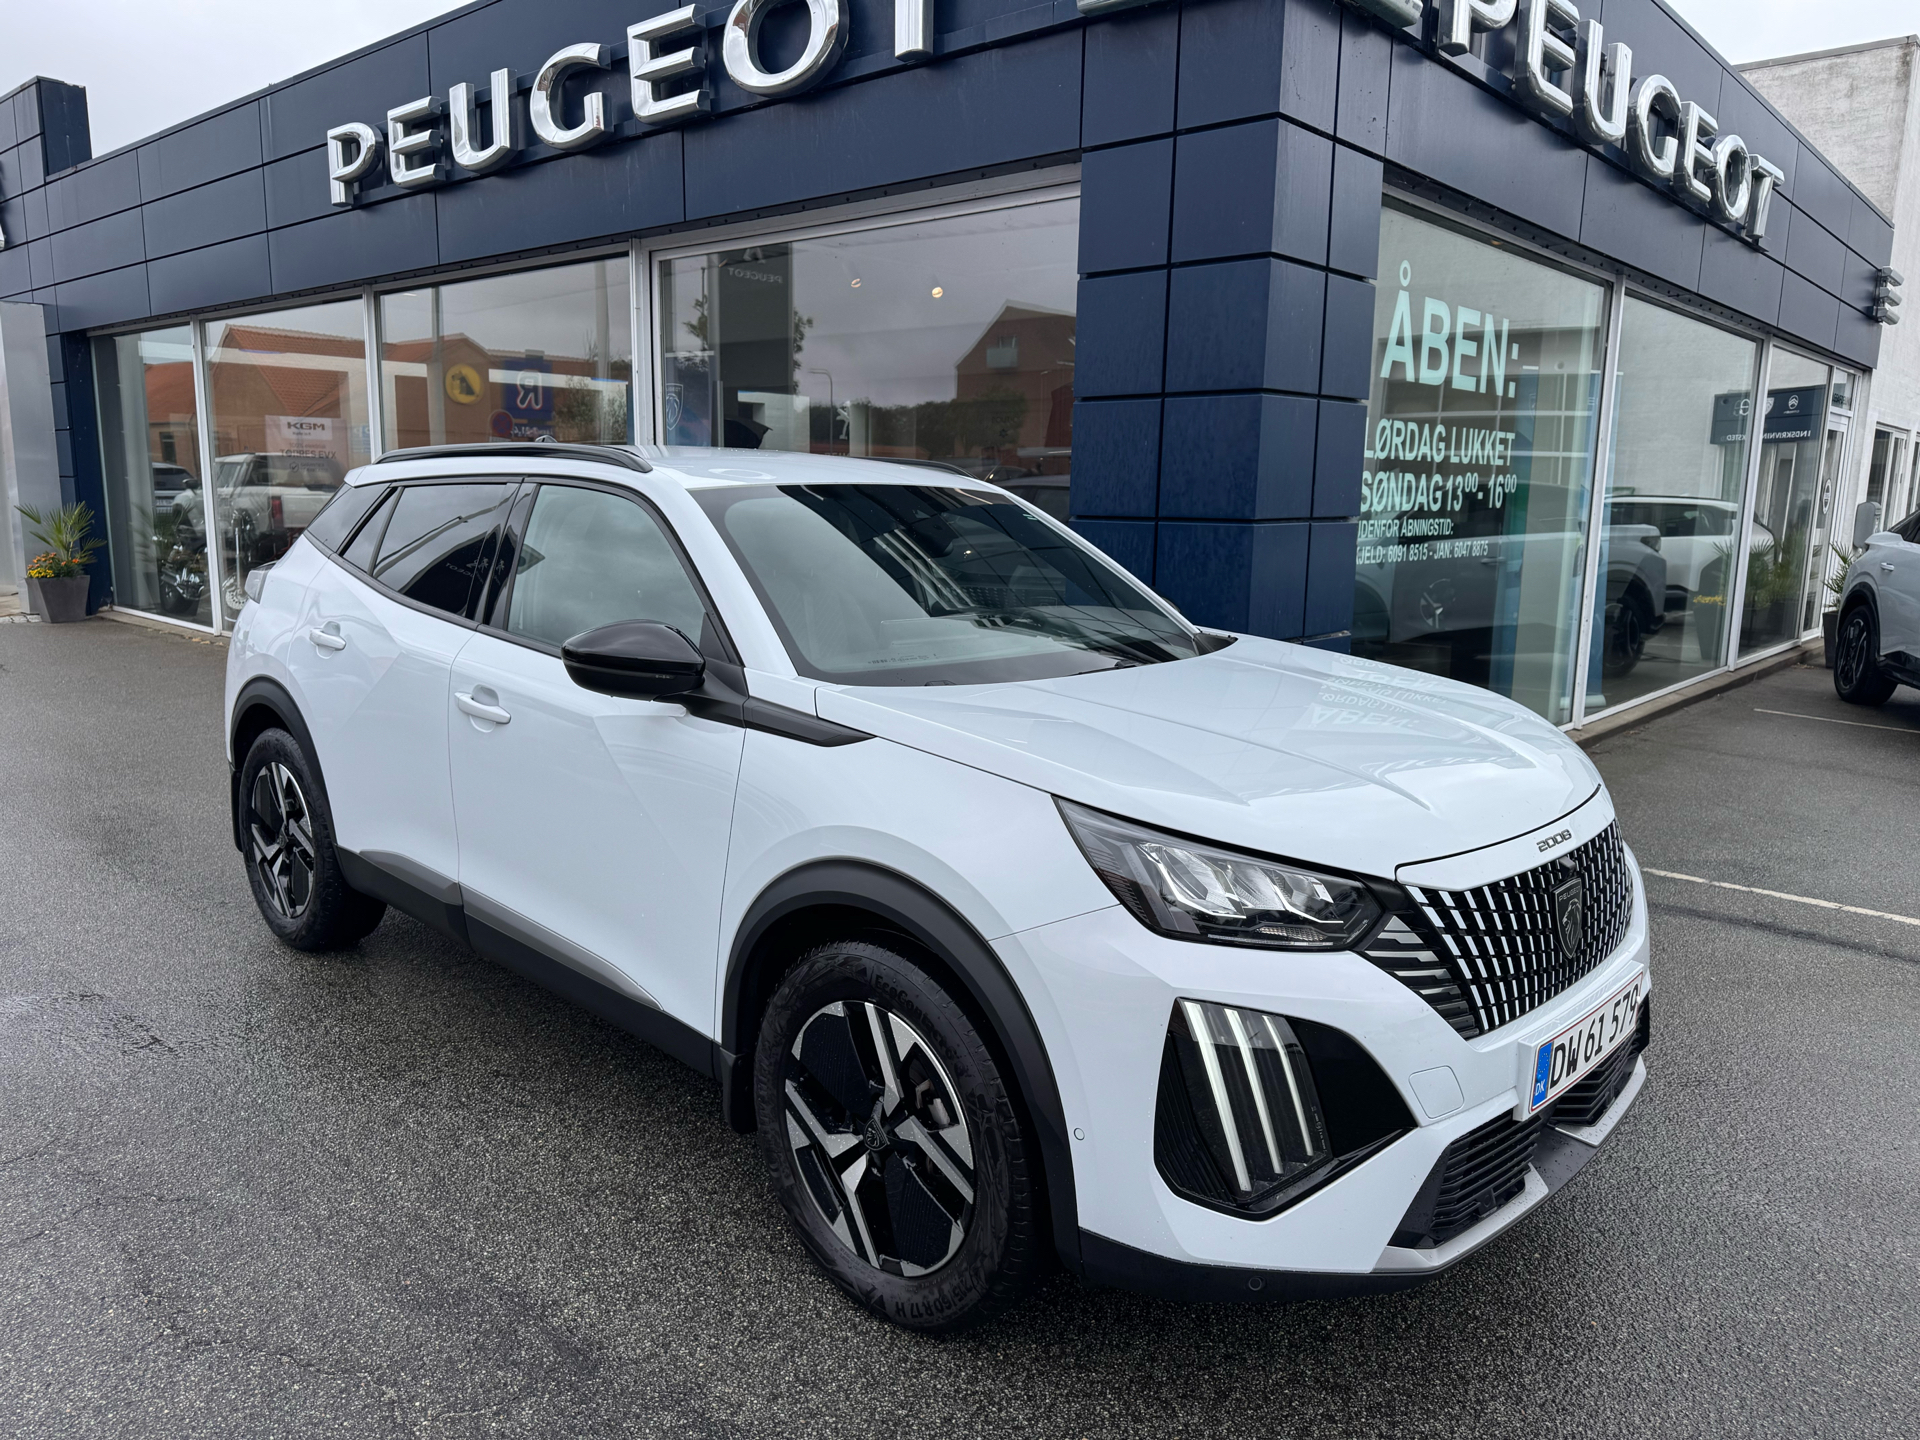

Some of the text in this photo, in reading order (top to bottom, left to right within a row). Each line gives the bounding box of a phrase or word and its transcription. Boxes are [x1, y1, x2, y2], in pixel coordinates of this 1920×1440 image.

[1380, 260, 1519, 398] ÅBEN:
[287, 421, 325, 431] KGM
[1364, 417, 1515, 466] LØRDAG LUKKET
[319, 450, 337, 460] EVX
[1361, 470, 1443, 512] SØNDAG
[1536, 829, 1572, 853] 2008
[1550, 983, 1639, 1090] DW 61 579
[1535, 1079, 1547, 1097] DK
